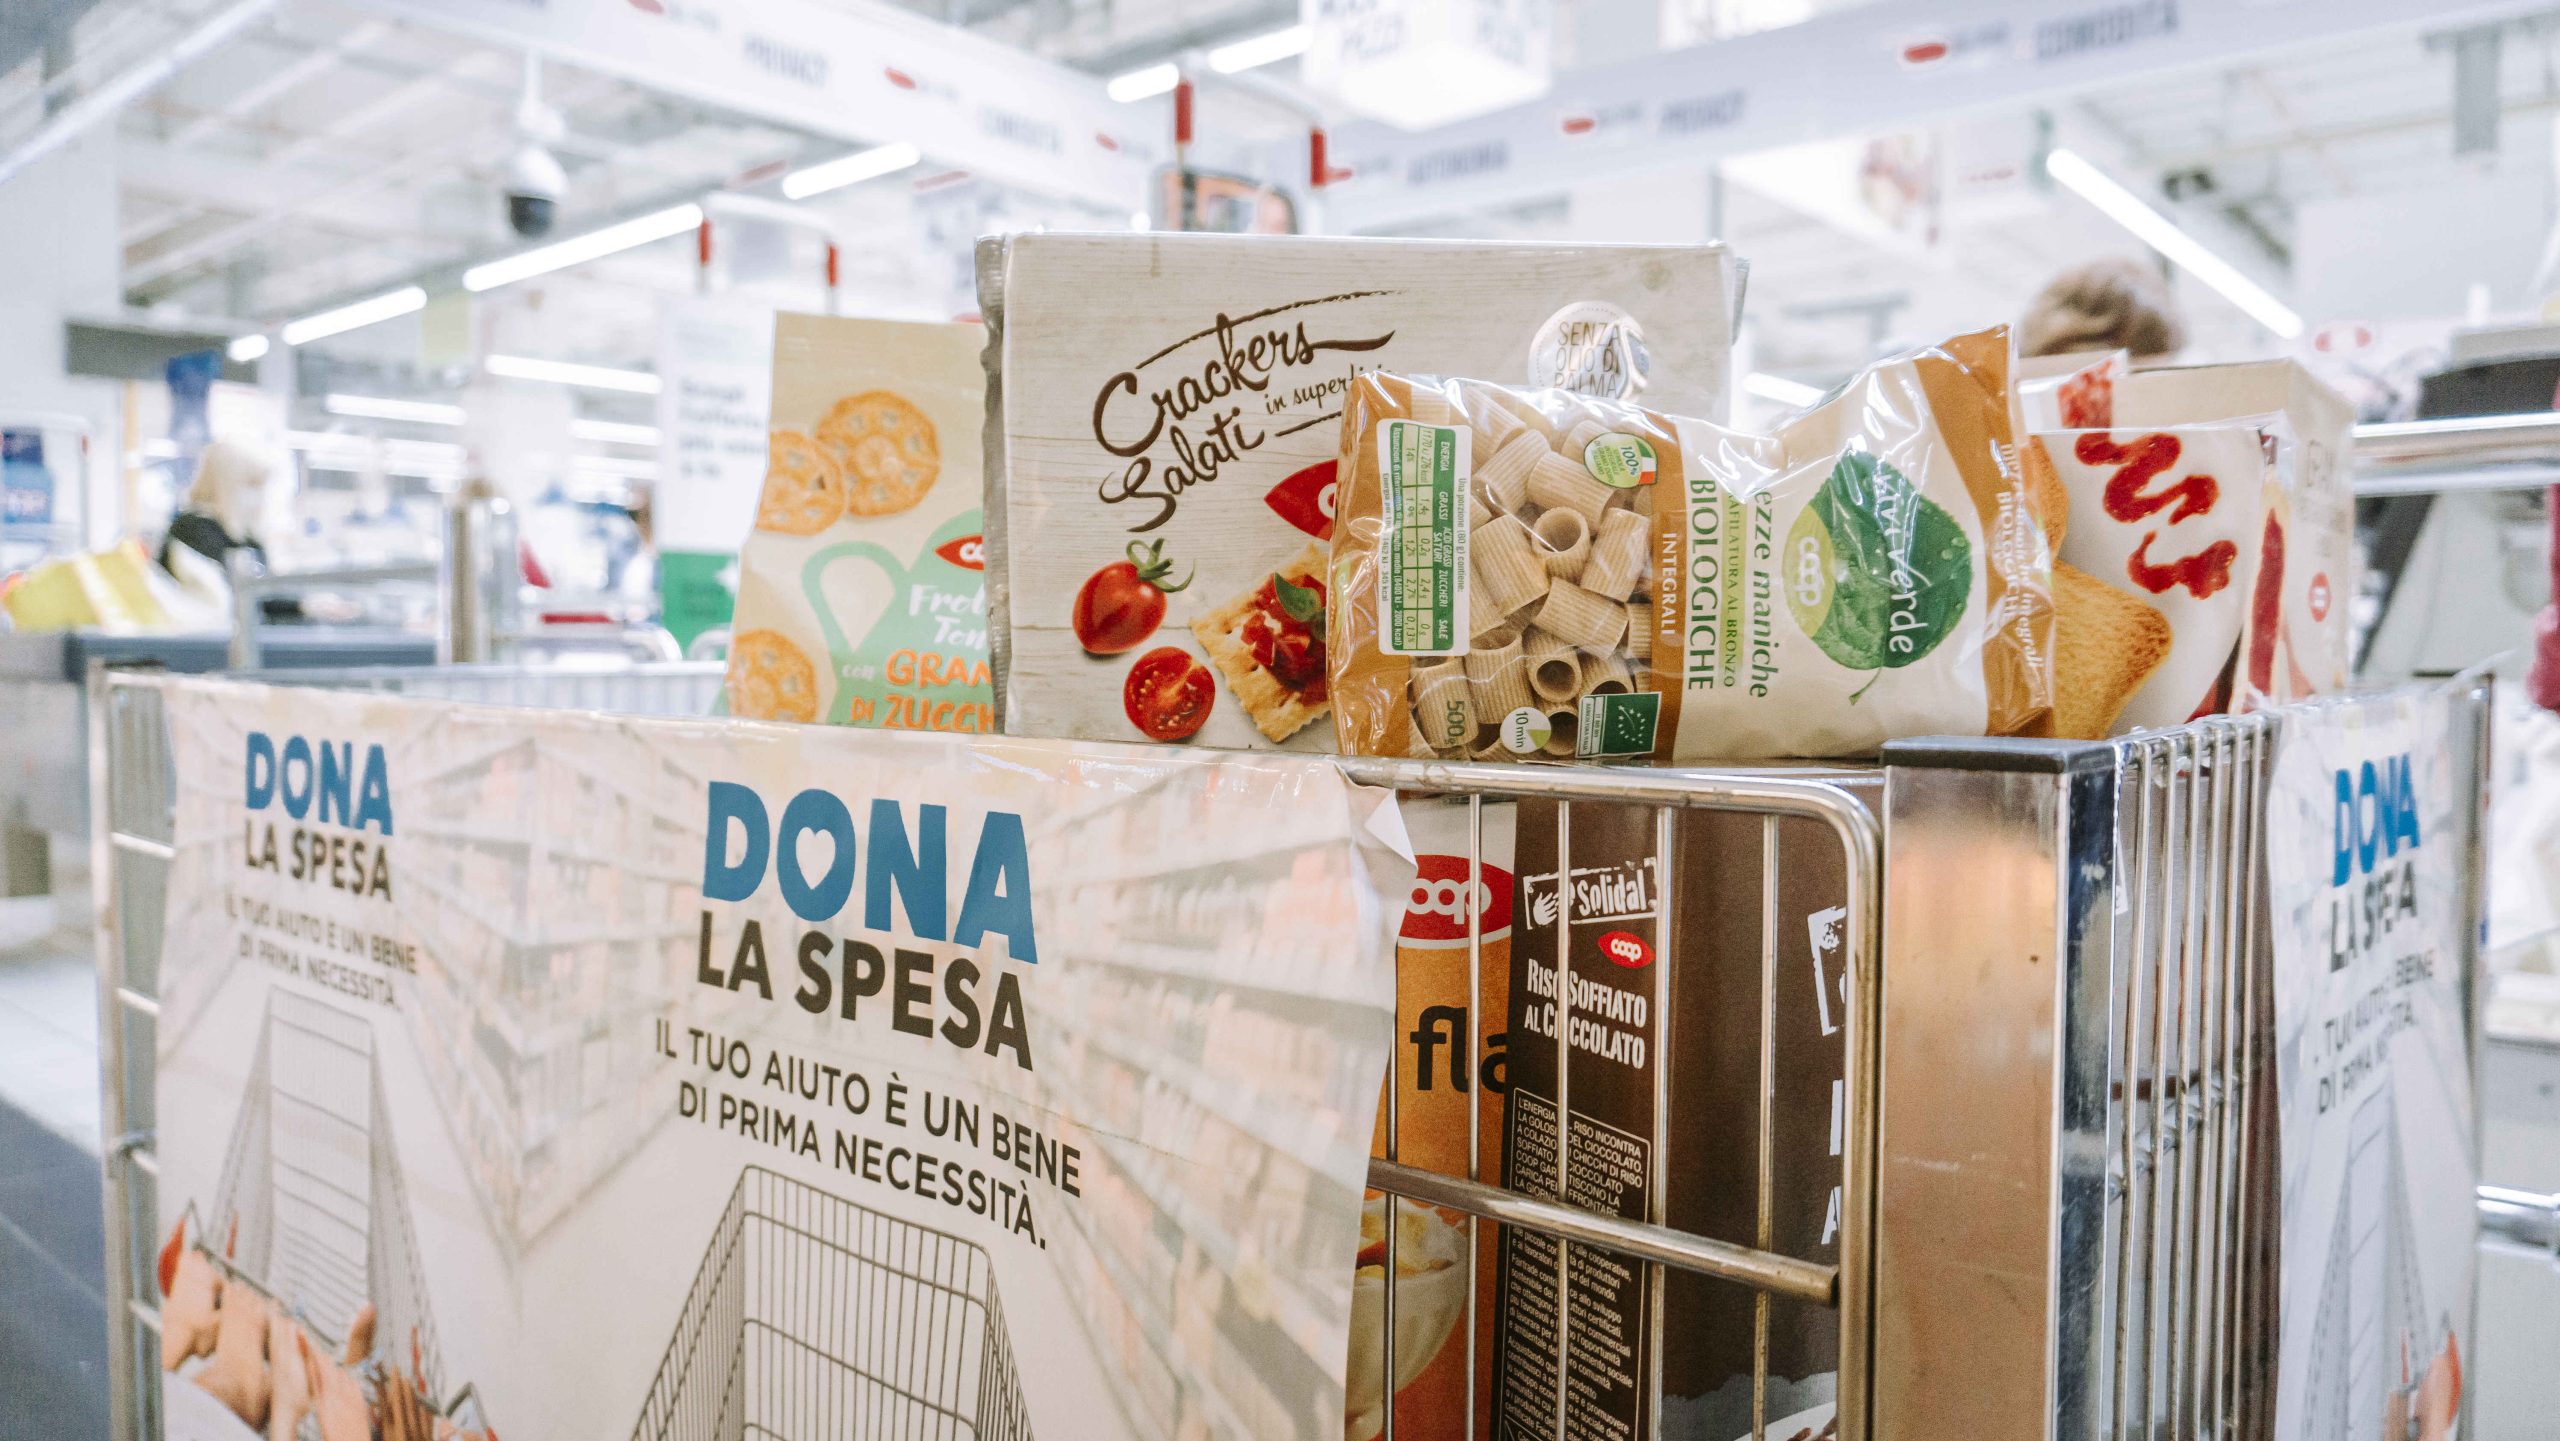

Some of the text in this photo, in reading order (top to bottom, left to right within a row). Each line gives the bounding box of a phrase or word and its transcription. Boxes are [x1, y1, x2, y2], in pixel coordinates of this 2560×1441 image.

[1558, 321, 1621, 347] SENZA
[1556, 347, 1619, 374] OLIO DI
[1093, 312, 1396, 457] Crackers
[1265, 364, 1357, 415] in super
[1554, 373, 1617, 398] PALMA
[1098, 407, 1265, 533] Salati
[1440, 441, 1451, 471] ENERGIA
[1620, 446, 1640, 476] 100%
[1439, 491, 1449, 520] GRASSI
[1457, 478, 1467, 492] Una
[1455, 494, 1467, 527] porzione
[1394, 553, 1402, 574] medio
[1433, 531, 1443, 563] SATURI
[1443, 527, 1452, 567] ACIDI GRASSI
[1438, 570, 1449, 607] ZUCCHERI
[1457, 556, 1467, 592] contiene:
[1661, 532, 1678, 635] INTEGRALI
[1688, 480, 1719, 690] BIOLOGICHE
[1723, 496, 1741, 687] AFILATURA AL BRONZO
[1793, 536, 1824, 607] coop
[908, 583, 986, 616] Frol
[1749, 491, 1780, 698] ezze maniche
[934, 615, 987, 650] Ten
[1393, 628, 1403, 646] kcal)
[1394, 610, 1402, 626] 2000
[1439, 619, 1449, 640] SALE
[841, 648, 993, 689] con GRAN
[849, 693, 995, 735] DI ZUCCH
[1515, 711, 1530, 748] 10 min
[245, 731, 394, 836] DONA
[2333, 752, 2420, 888] DONA
[245, 819, 392, 902] LA SPESA
[702, 781, 1039, 965] DONA
[1405, 878, 1491, 925] oop
[1577, 869, 1647, 916] Solidal
[239, 933, 253, 958] DI
[258, 940, 299, 975] PRIMA
[276, 908, 321, 944] AIUTO
[341, 926, 366, 957] UN
[370, 934, 418, 975] BENE
[1611, 938, 1642, 962] coop
[2330, 894, 2358, 973] LA
[698, 910, 1033, 1071] LA SPESA
[1568, 970, 1648, 1028] SOFFIATO
[1409, 1005, 1507, 1094] fla
[1524, 1003, 1646, 1070] AL CICCOLATO
[656, 1018, 1081, 1198] IL TUO AIUTO È UN BENE
[2319, 1071, 2336, 1115] DI
[1516, 1135, 1552, 1162] SOFFIATO
[1518, 1096, 1640, 1159] L'ENERGIA RISO INCONTRA
[1518, 1110, 1527, 1124] LA
[1528, 1114, 1556, 1138] GOLOSI
[1584, 1137, 1643, 1175] CIOCCOLATO.
[679, 1081, 1047, 1251] DI PRIMA NECESSITÀ.
[1516, 1123, 1522, 1135] A
[1523, 1126, 1557, 1151] COLAZIO
[1572, 1148, 1607, 1175] CHICCHI
[1609, 1164, 1618, 1178] DI
[1620, 1168, 1642, 1190] RISO
[1515, 1176, 1524, 1191] LA
[1515, 1162, 1543, 1186] CARICA
[1568, 1187, 1619, 1219] FFRONTARE
[1516, 1149, 1620, 1208] COOP GARTISCONO LA
[1587, 1323, 1630, 1359] commerciali
[1568, 1374, 1596, 1401] prodotto
[1607, 1364, 1632, 1389] sociale
[1586, 1400, 1629, 1435] promuovere
